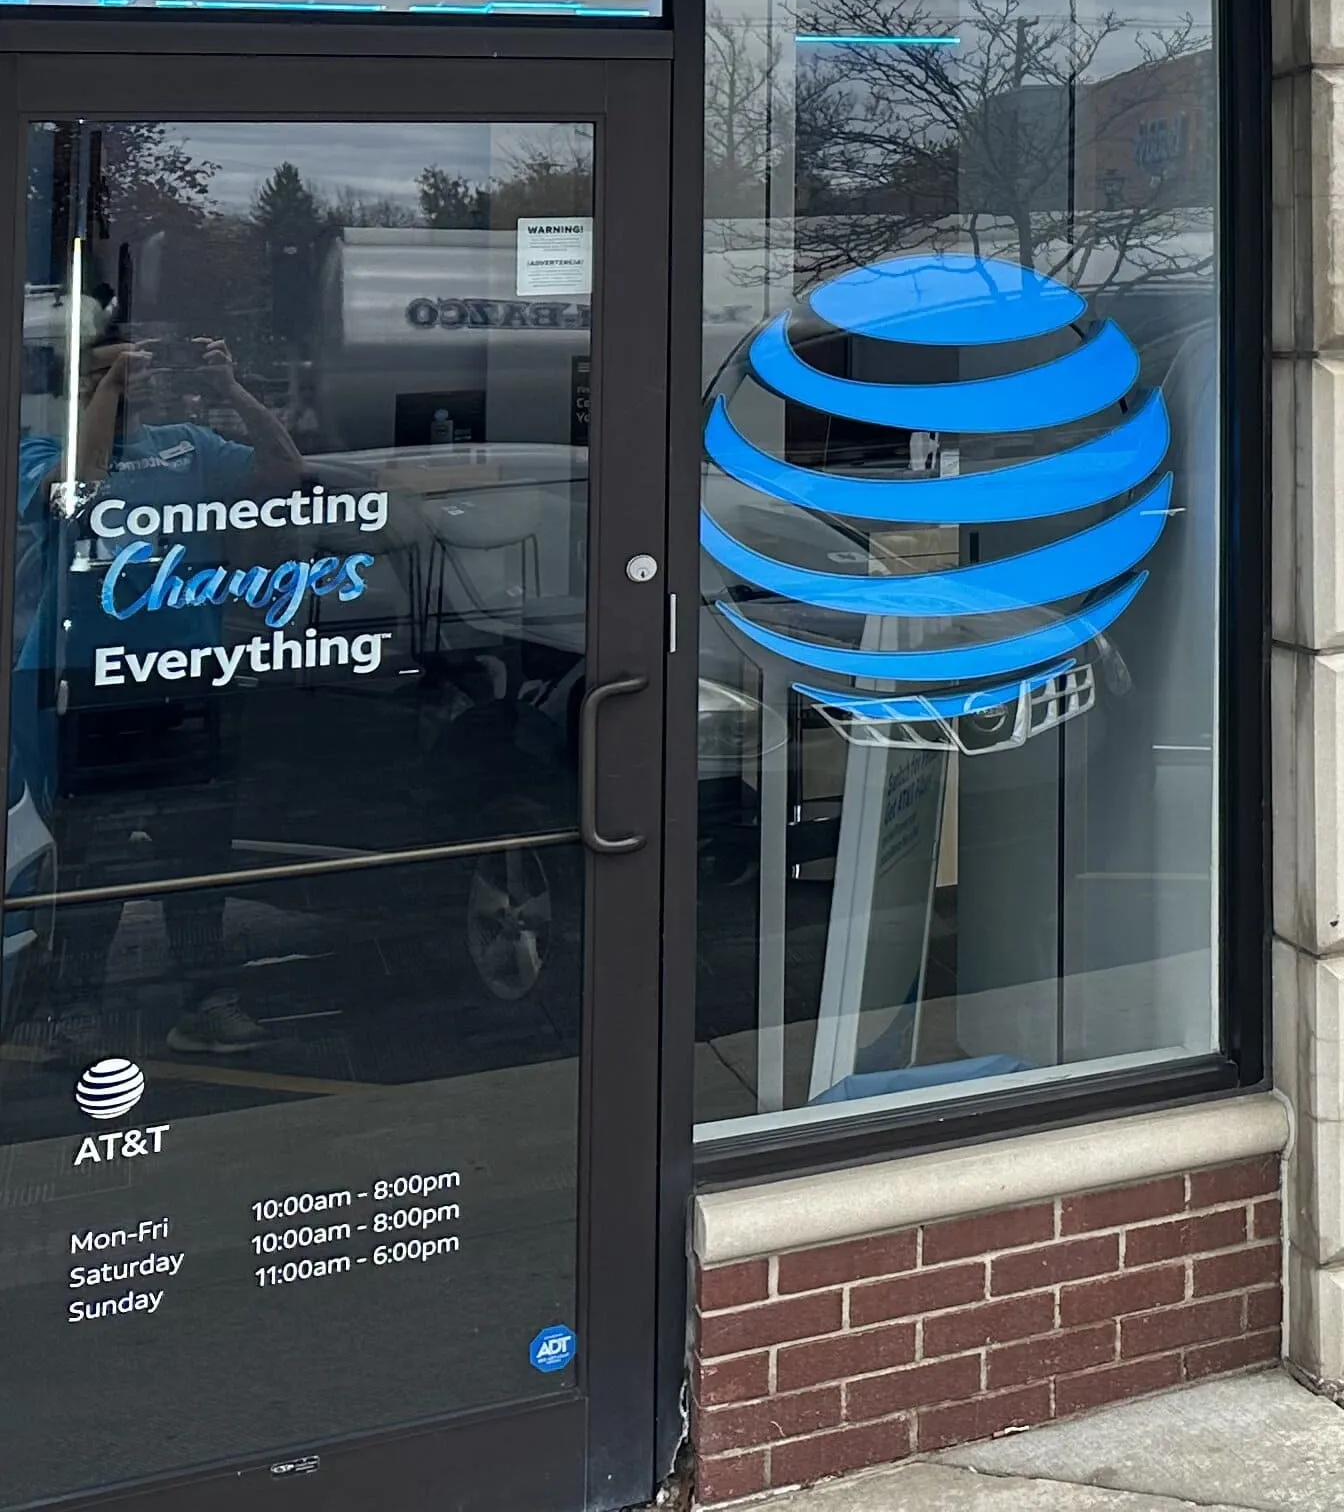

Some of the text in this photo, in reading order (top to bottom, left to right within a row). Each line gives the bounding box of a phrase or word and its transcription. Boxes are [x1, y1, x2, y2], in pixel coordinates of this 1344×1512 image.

[527, 225, 584, 235] WARNING!
[90, 486, 388, 538] Connecting
[101, 541, 374, 627] Changes
[74, 1125, 170, 1166] AT&T
[69, 1252, 185, 1289] Saturday
[251, 1222, 351, 1255] 10:00am
[373, 1202, 460, 1233] 8:00pm
[70, 1218, 169, 1254] Mon-Fri
[251, 1189, 351, 1222] 10:00am
[373, 1170, 461, 1201] 8:00pm
[68, 1290, 164, 1324] Sunday
[255, 1254, 351, 1288] 11:00am
[373, 1235, 460, 1265] 6:00pm
[535, 1335, 572, 1359] ADT
